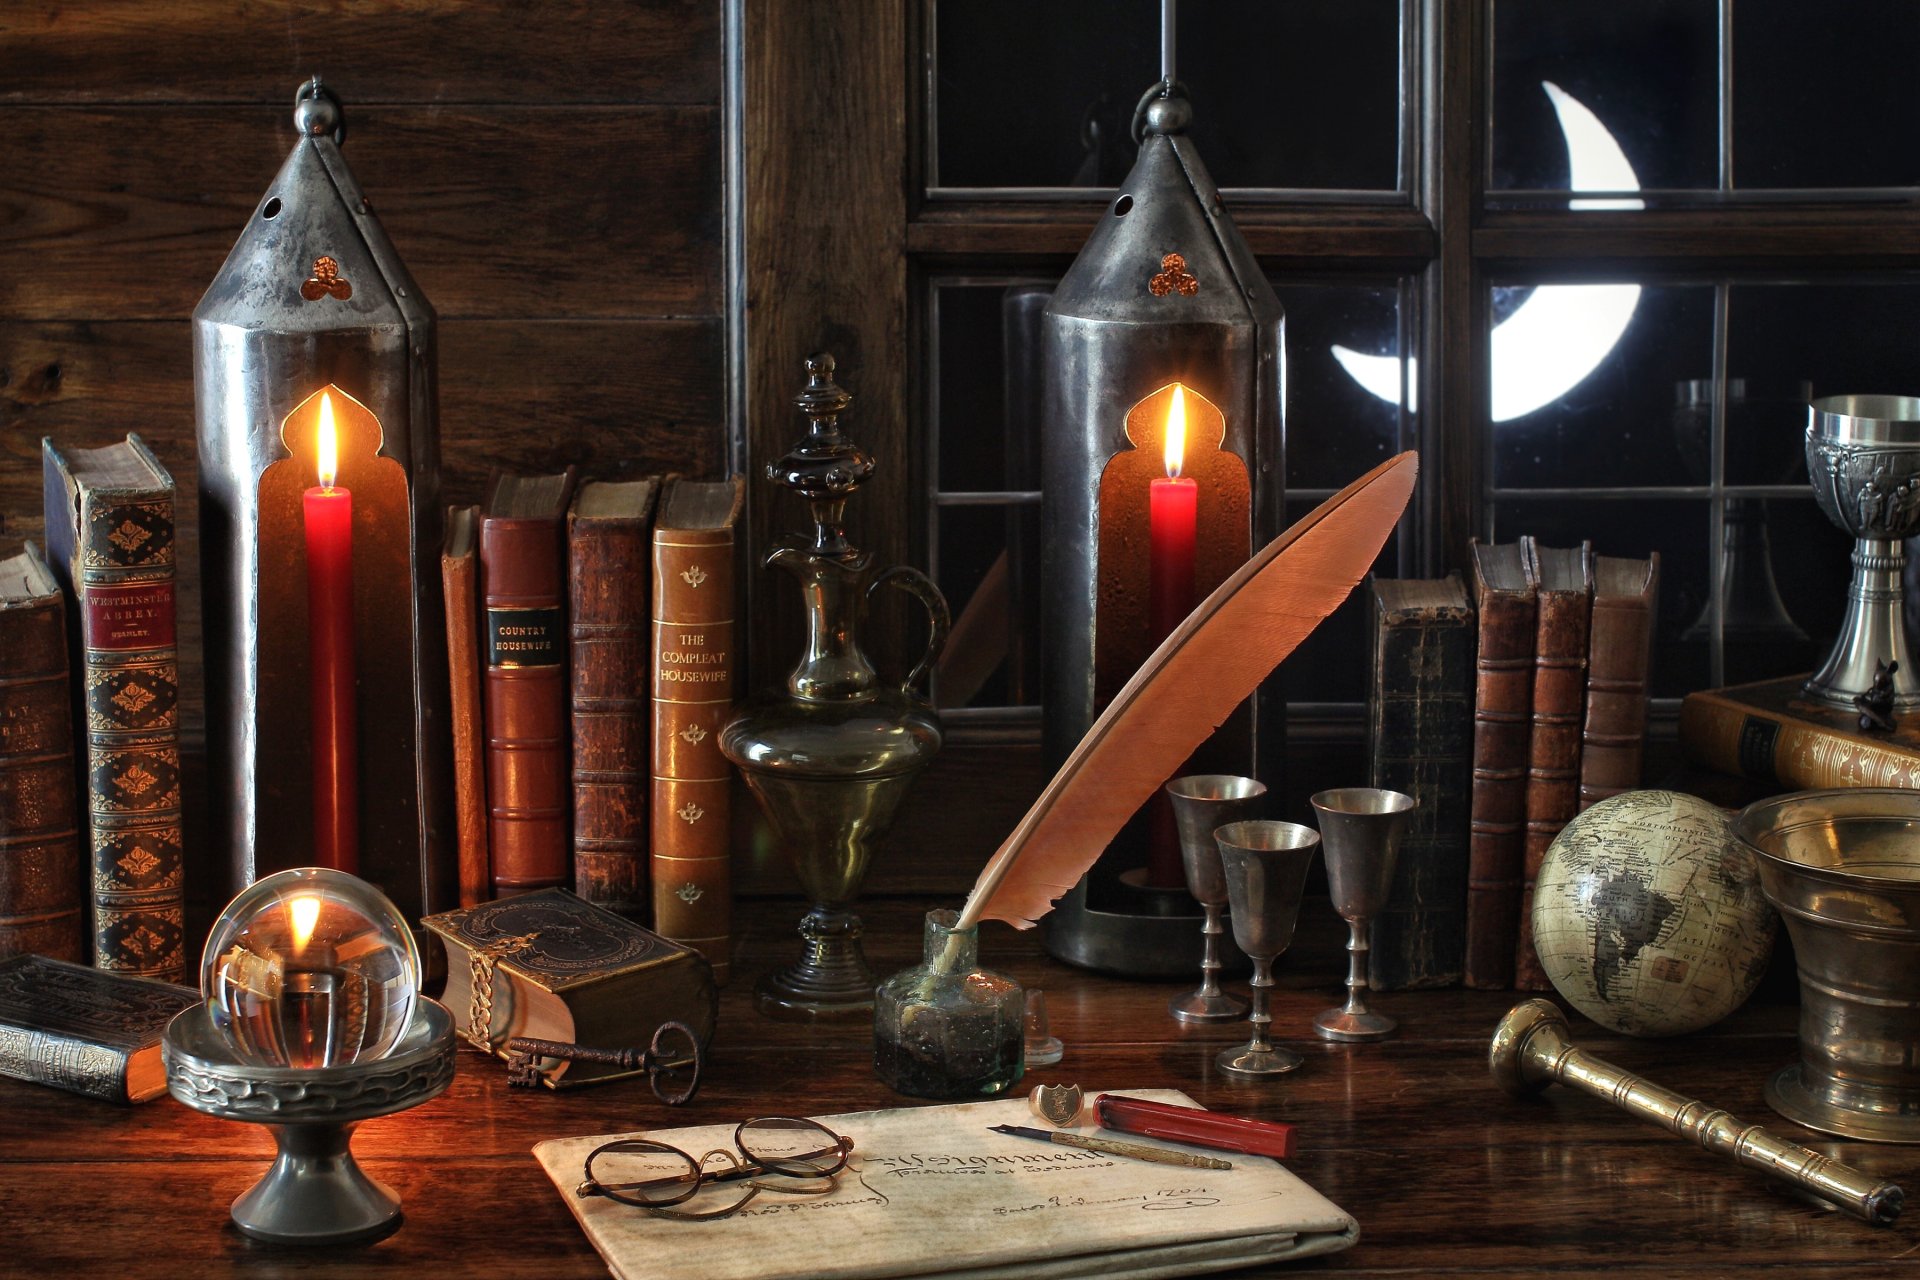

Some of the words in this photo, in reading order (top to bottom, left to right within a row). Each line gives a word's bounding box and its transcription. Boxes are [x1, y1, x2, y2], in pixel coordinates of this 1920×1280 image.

[90, 594, 170, 606] WESTMINSTER
[499, 627, 546, 636] COUNTRY
[496, 641, 551, 650] HOUSEWIFE
[680, 634, 704, 646] THE
[662, 651, 725, 664] COMPLEAT
[660, 669, 727, 682] HOUSEWIFE
